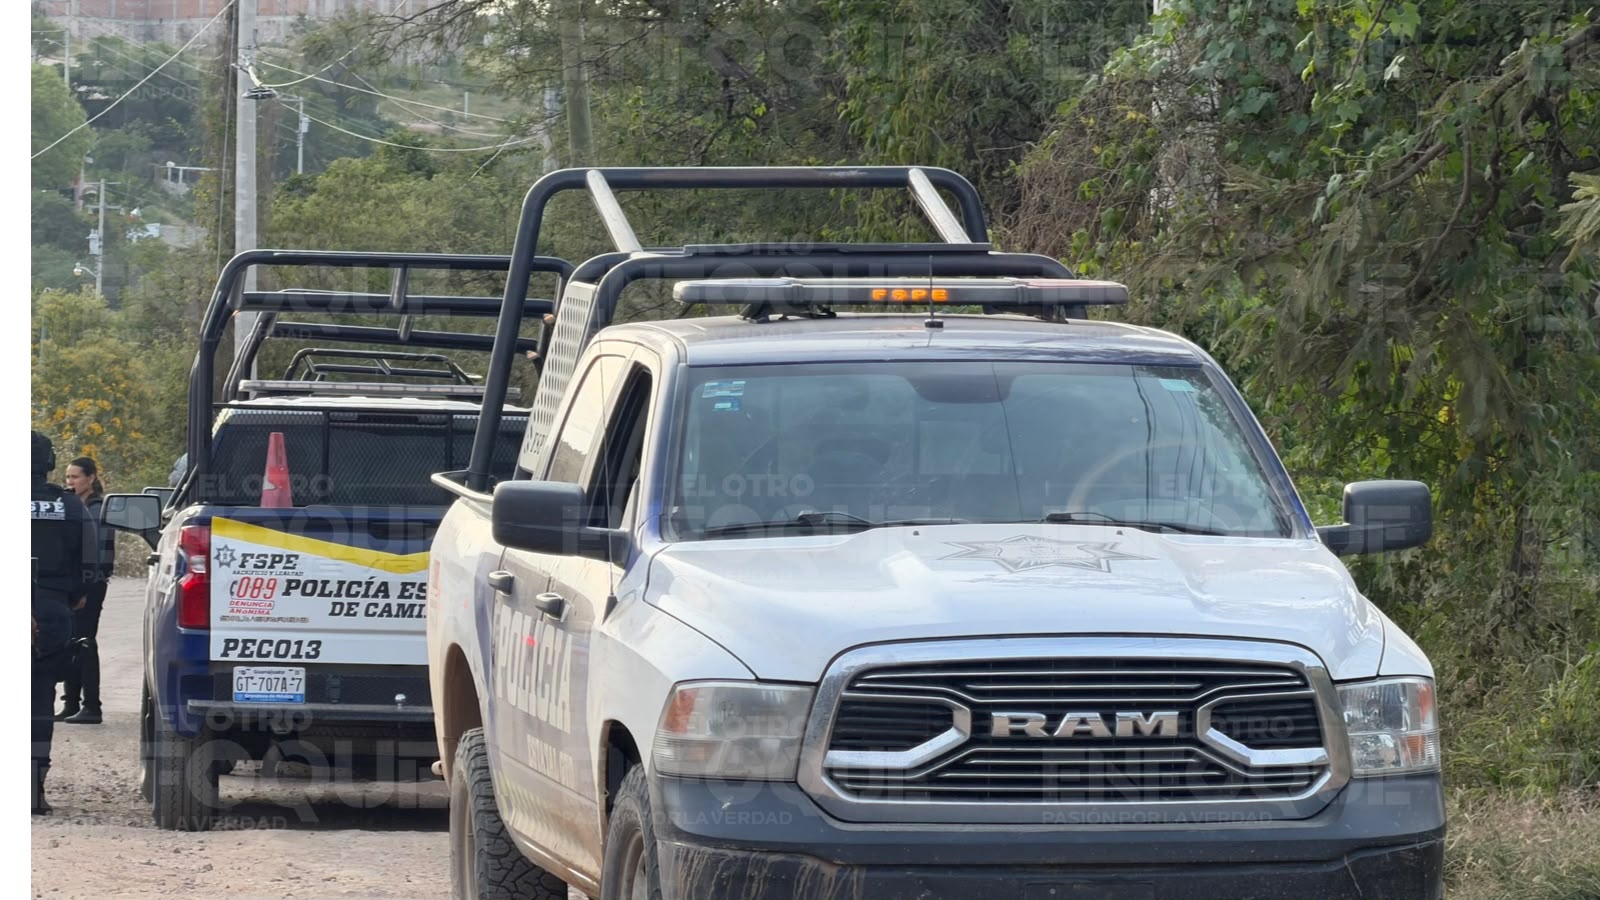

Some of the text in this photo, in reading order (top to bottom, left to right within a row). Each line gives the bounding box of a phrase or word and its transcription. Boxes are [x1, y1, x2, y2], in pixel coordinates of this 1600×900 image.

[239, 553, 299, 570] FSPE
[282, 576, 390, 599] POLICÍA
[328, 602, 360, 617] DE
[236, 676, 303, 692] GT-707A-7
[991, 711, 1179, 737] RAM
